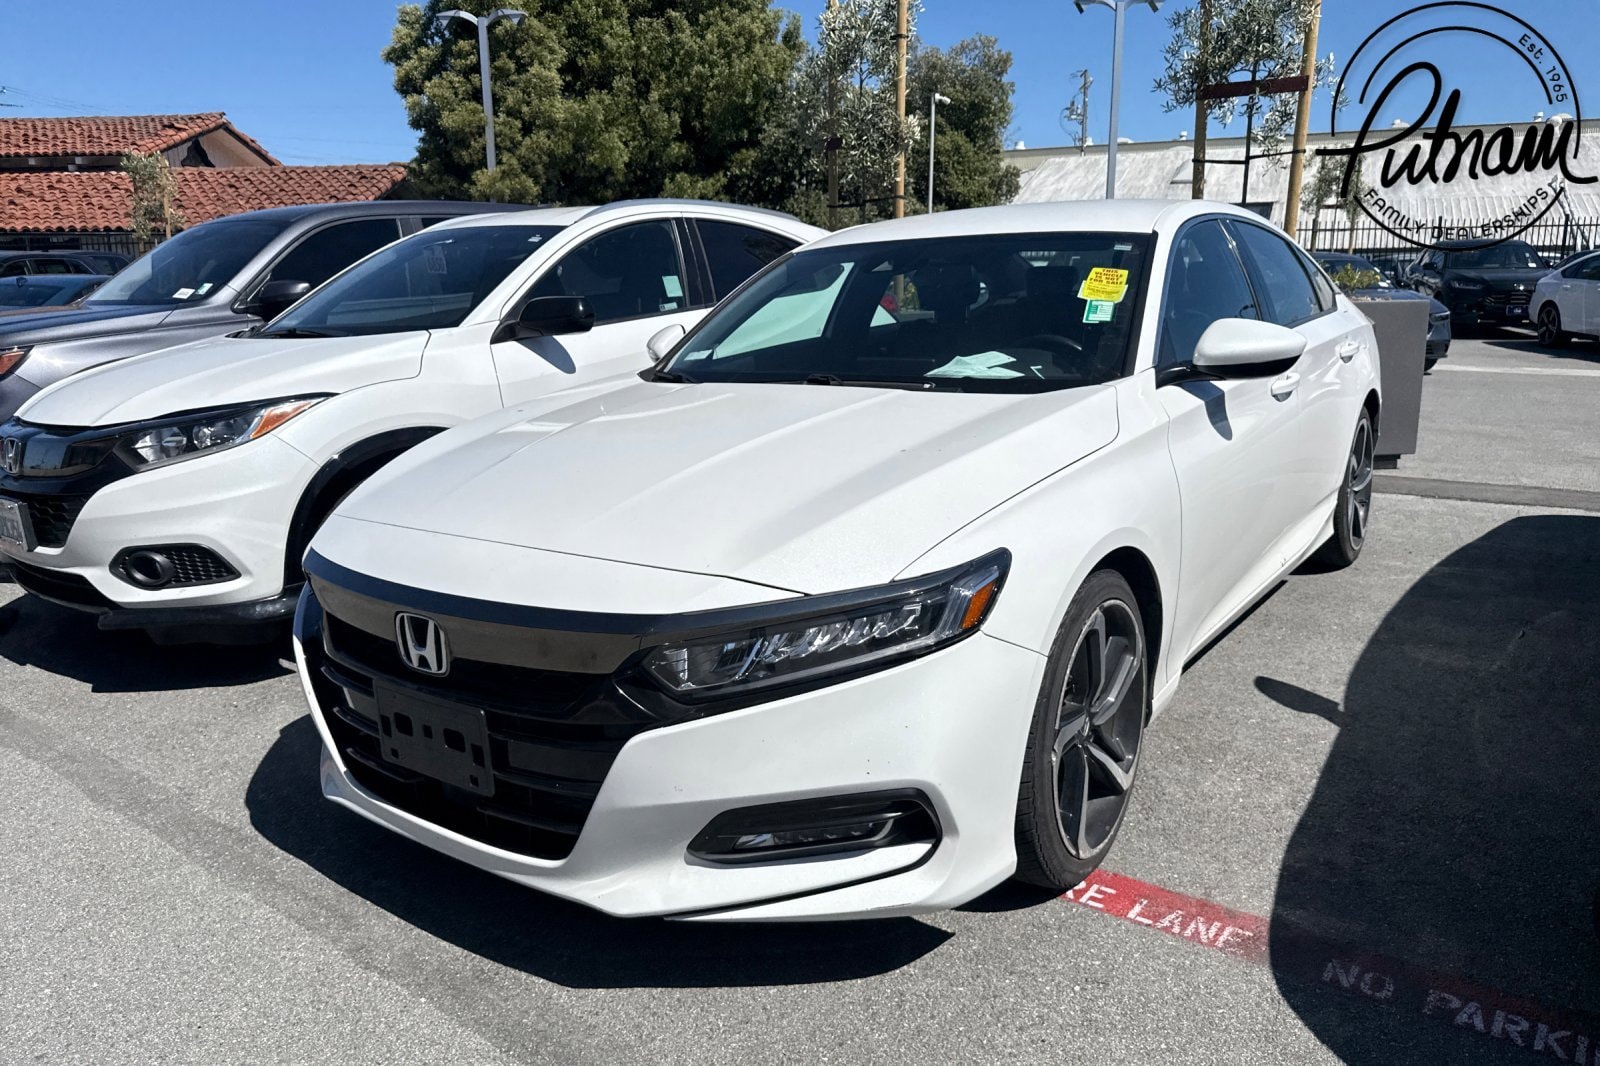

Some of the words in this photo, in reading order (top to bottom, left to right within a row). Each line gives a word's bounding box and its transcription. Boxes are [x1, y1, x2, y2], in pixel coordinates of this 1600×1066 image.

[1127, 898, 1254, 948] LANE
[1322, 959, 1395, 999] NO
[1421, 989, 1600, 1066] PARKI
